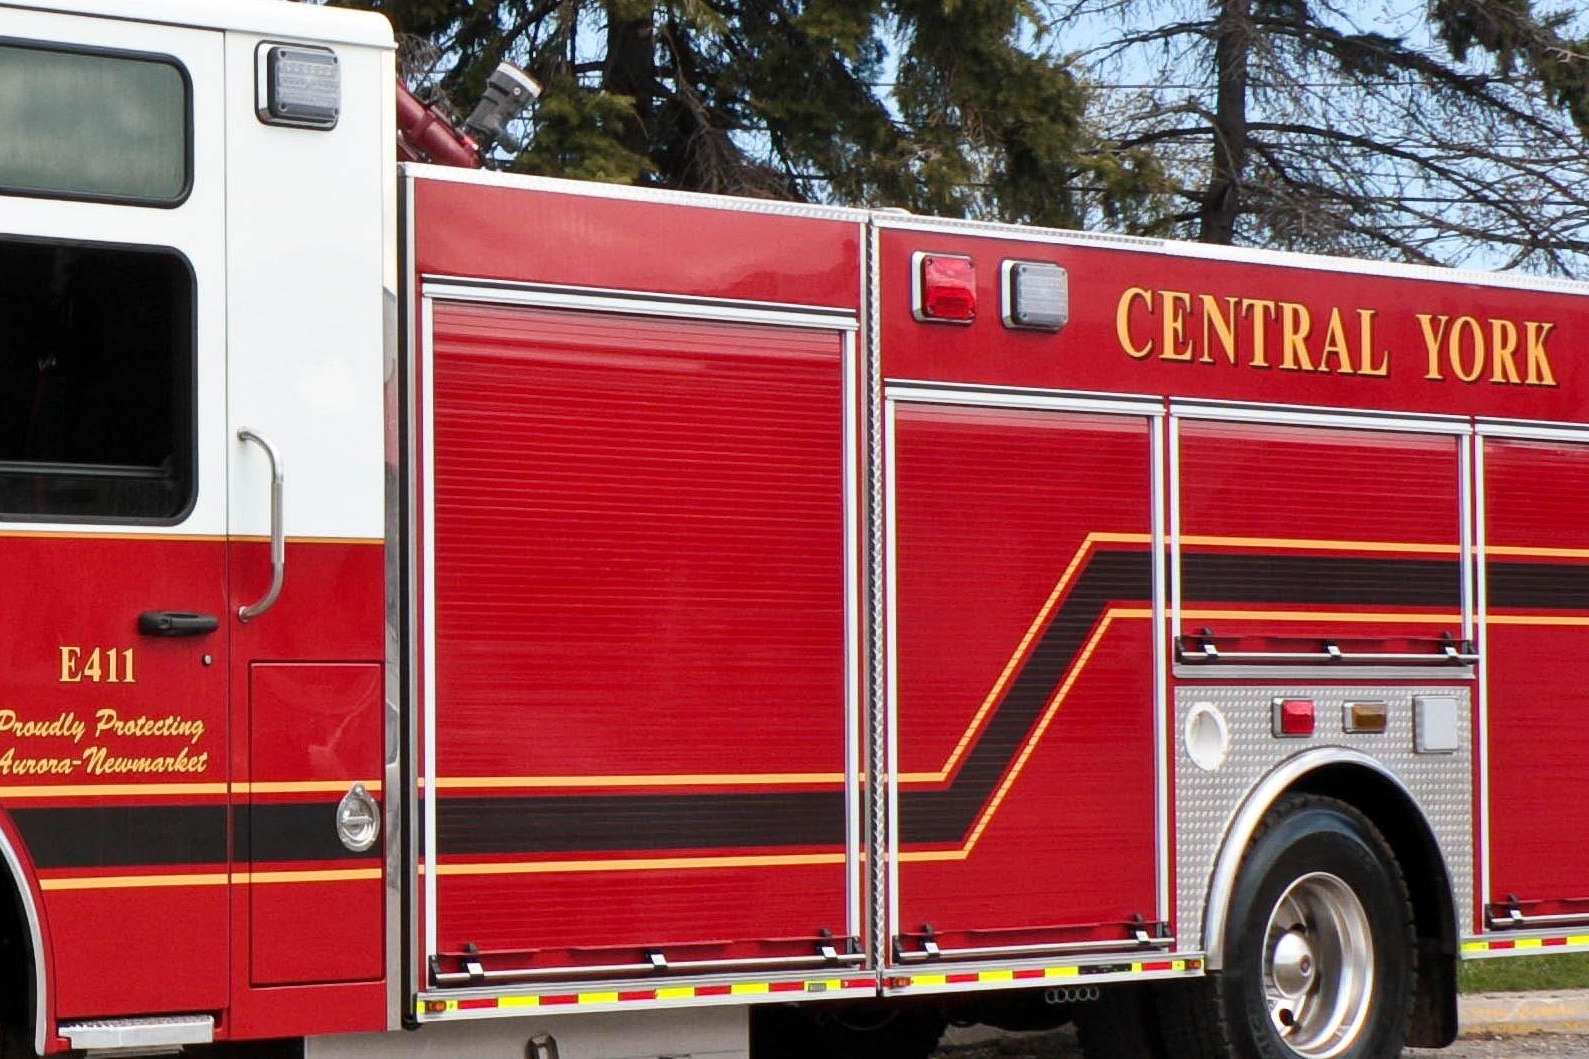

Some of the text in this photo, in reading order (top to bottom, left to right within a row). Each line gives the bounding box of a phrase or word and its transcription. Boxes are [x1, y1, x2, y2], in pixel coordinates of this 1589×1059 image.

[1116, 287, 1558, 387] CENTRAL YORK
[59, 646, 137, 683] E411
[95, 708, 205, 744] Protecting
